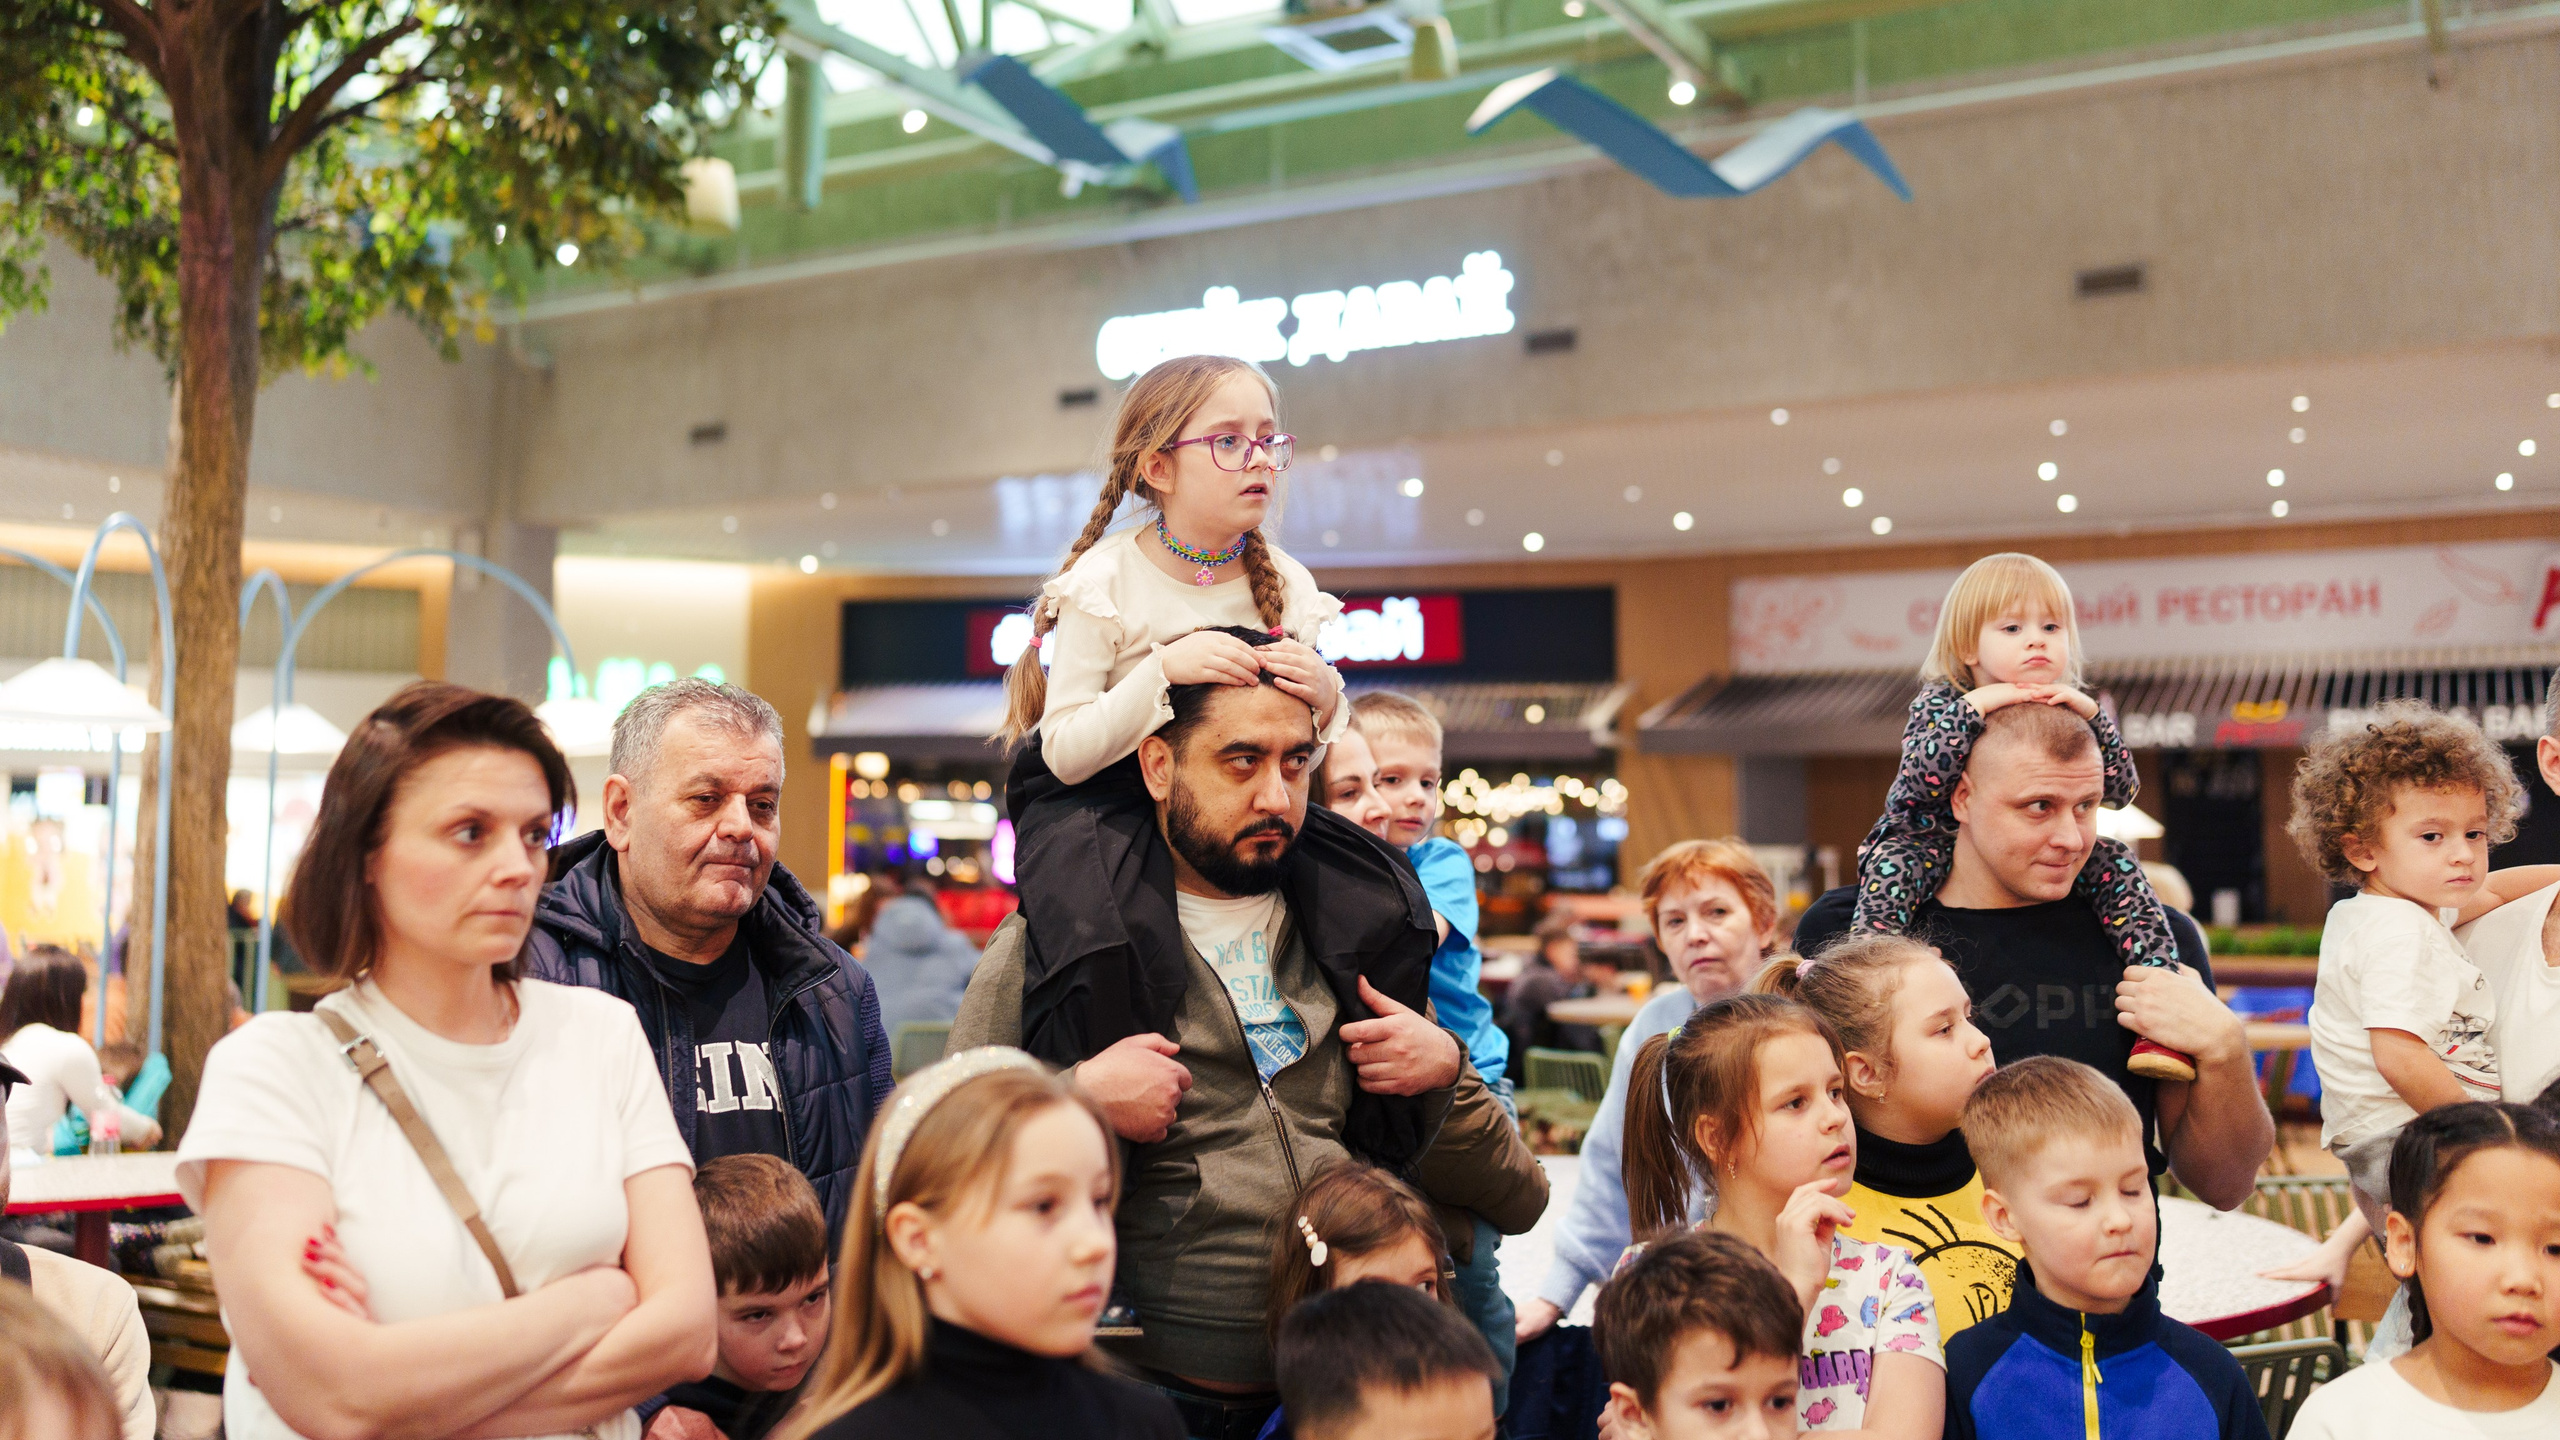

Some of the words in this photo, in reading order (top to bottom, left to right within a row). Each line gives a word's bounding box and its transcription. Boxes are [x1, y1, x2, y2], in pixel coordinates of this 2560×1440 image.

[2155, 578, 2383, 626] РЕСТОРАН
[2121, 711, 2198, 749] BAR
[1214, 939, 1246, 968] NEW
